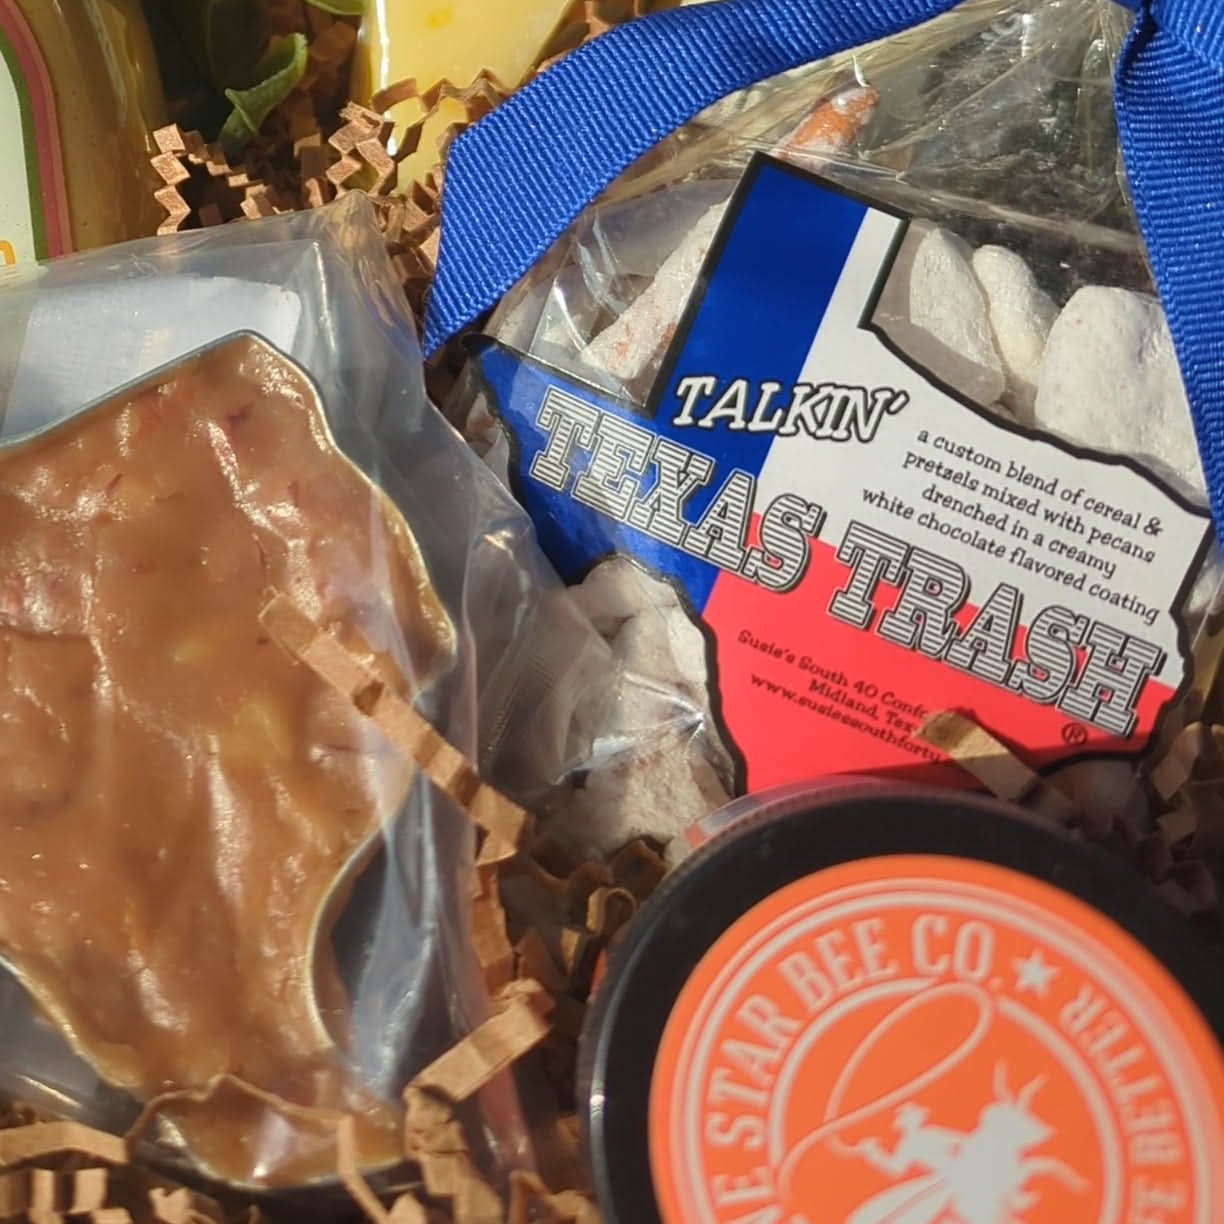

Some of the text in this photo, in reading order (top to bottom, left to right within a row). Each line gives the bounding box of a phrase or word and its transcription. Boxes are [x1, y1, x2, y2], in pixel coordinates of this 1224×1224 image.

[673, 375, 910, 443] TALKIN'
[901, 451, 1157, 564] pretzels mixed with pecans
[917, 429, 1164, 537] a custom blend of cereal &
[921, 483, 1118, 580] drenched in a creamy
[527, 385, 823, 595] TEXAS
[828, 520, 1167, 737] TRASH
[862, 487, 1161, 626] white chocolate flavored coating
[737, 630, 795, 665] Susie's
[798, 655, 849, 687] South
[853, 679, 879, 699] 40
[750, 674, 942, 763] www.susiessouthforty
[706, 913, 1006, 1152] STAR BEE CO.
[1059, 984, 1184, 1166] BETTER
